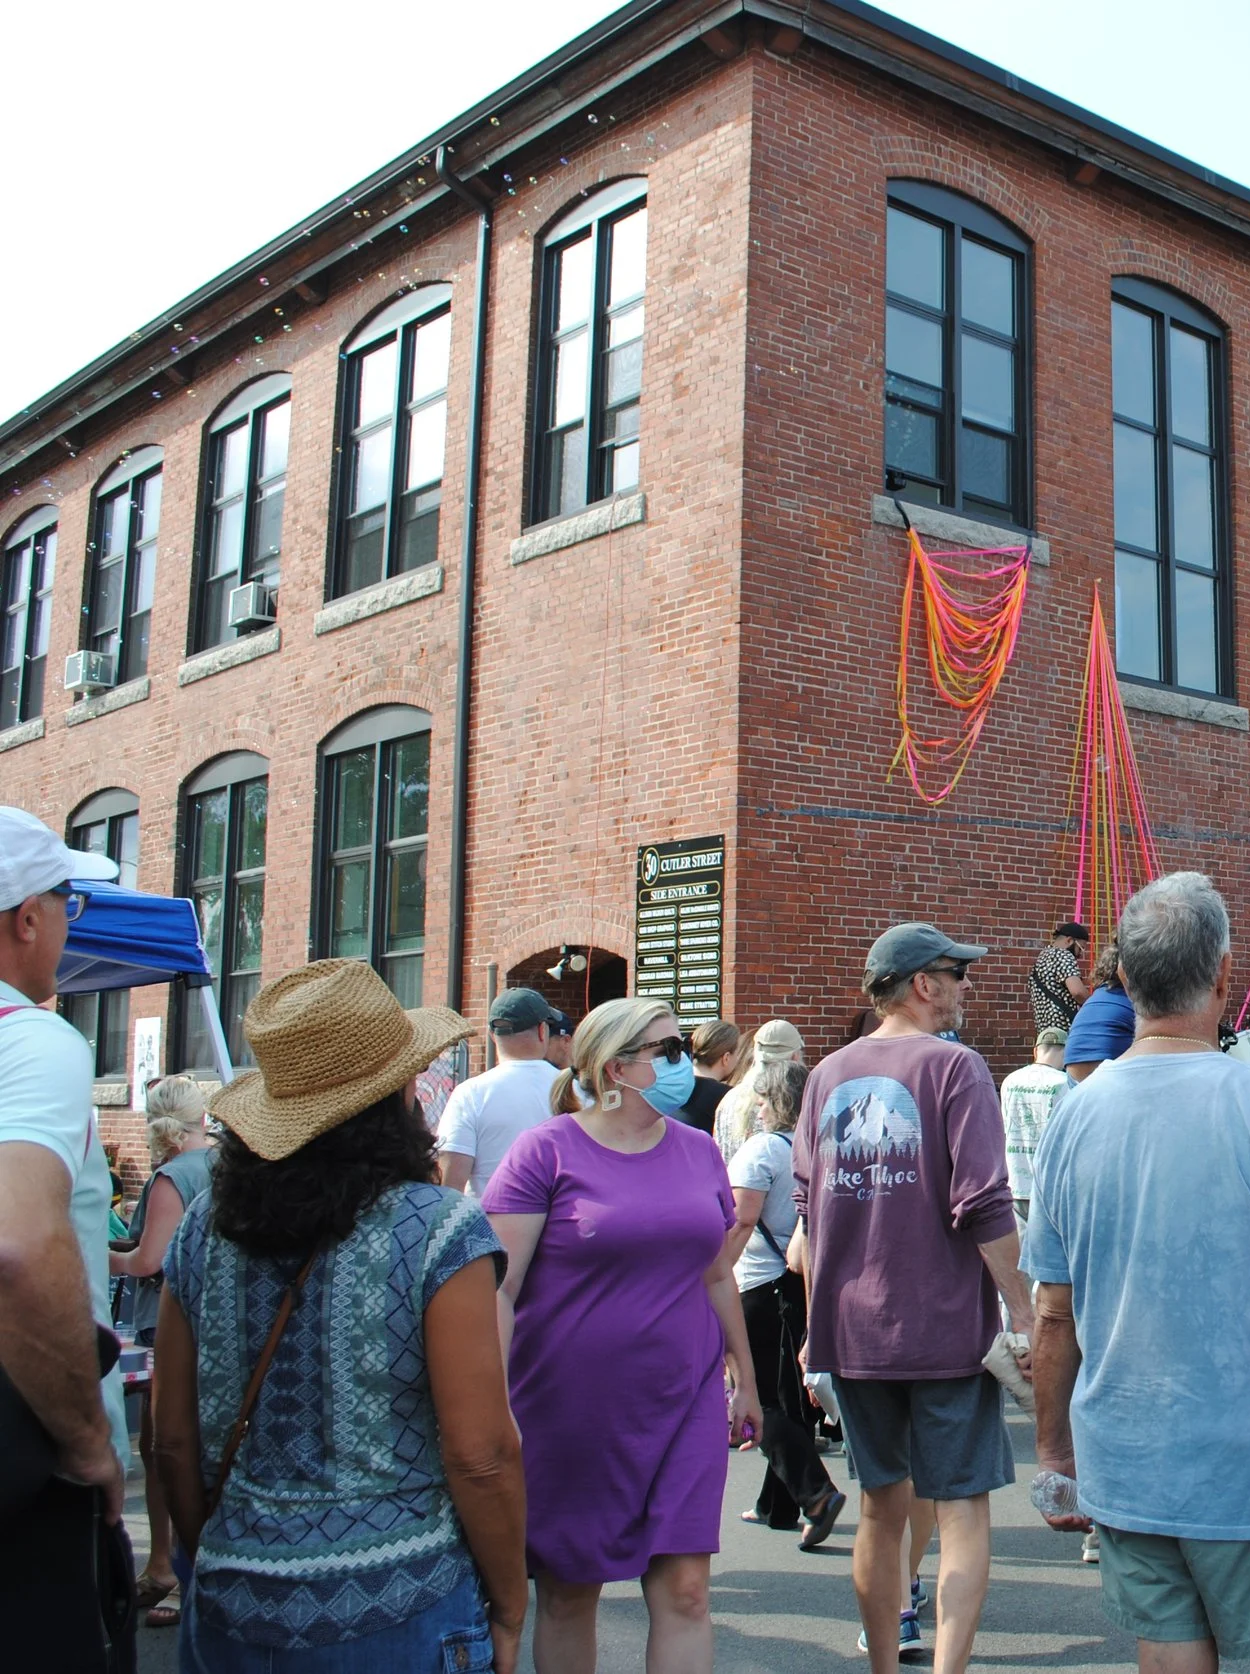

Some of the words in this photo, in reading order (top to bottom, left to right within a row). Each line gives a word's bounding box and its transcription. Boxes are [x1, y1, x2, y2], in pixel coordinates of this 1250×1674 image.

[645, 853, 657, 880] 30
[661, 856, 691, 872] CUTLER
[692, 852, 723, 868] STREET
[650, 890, 667, 901] SIDE
[668, 884, 708, 899] ENTRANCE
